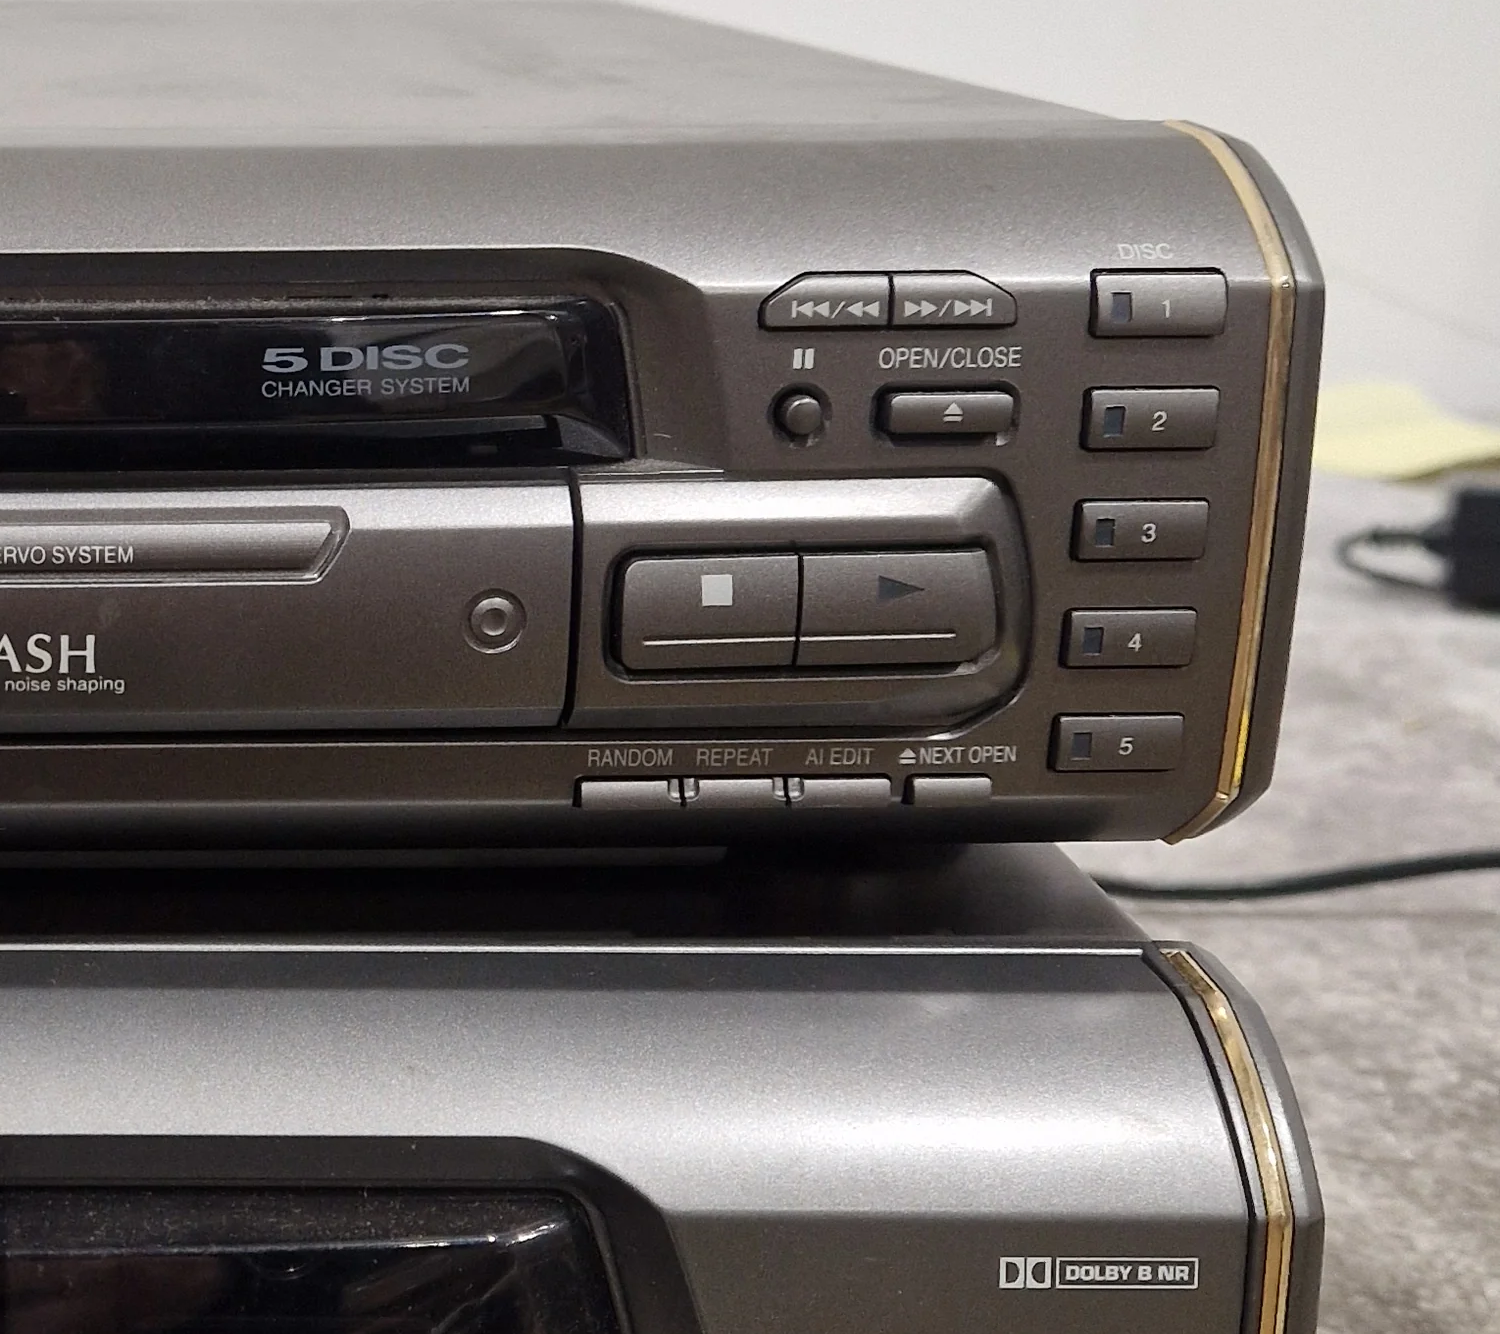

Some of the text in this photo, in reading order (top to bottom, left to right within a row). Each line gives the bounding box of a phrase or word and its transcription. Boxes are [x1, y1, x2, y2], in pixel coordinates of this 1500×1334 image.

[1117, 242, 1173, 261] DISC
[1161, 299, 1171, 319] 1
[261, 343, 470, 373] 5 DISC
[878, 346, 1022, 370] OPEN/CLOSE
[261, 376, 470, 398] CHANGER SYSTEM
[1151, 410, 1167, 431] 2
[1141, 523, 1157, 544] 3
[51, 545, 134, 564] SYSTEM
[1128, 632, 1143, 652] 4
[4, 676, 51, 692] noise
[56, 676, 125, 695] shaping
[829, 747, 876, 765] EDIT
[918, 746, 1017, 764] NEXT OPEN
[1119, 737, 1134, 756] 5
[587, 749, 674, 767] RANDOM
[696, 748, 774, 766] REPEAT
[1065, 1265, 1190, 1281] DOLBY B NR
